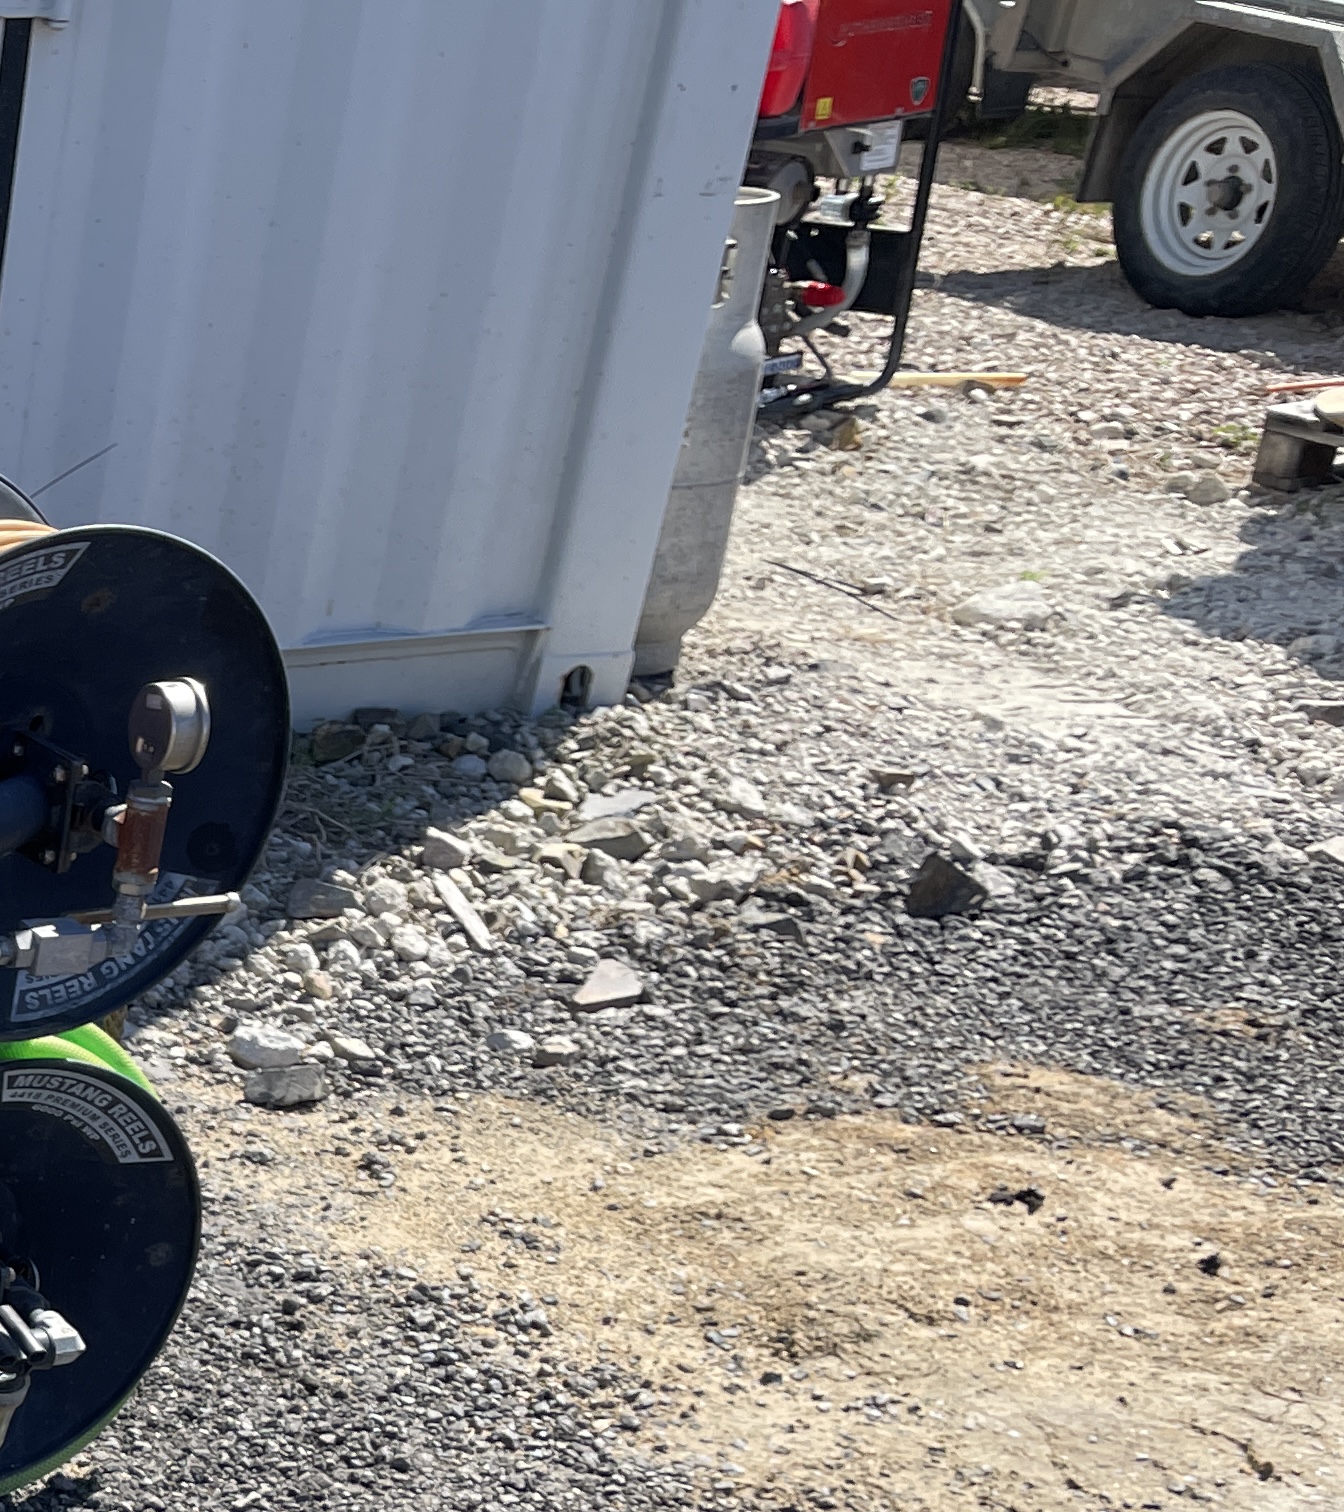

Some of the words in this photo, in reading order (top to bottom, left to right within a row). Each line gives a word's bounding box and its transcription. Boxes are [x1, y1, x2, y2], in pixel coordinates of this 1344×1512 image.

[25, 971, 99, 1010] REELS
[13, 1074, 111, 1108] MUSTANG
[107, 1103, 158, 1154] REELS
[43, 1094, 102, 1123] PREMIUM
[99, 1119, 132, 1159] SERIES
